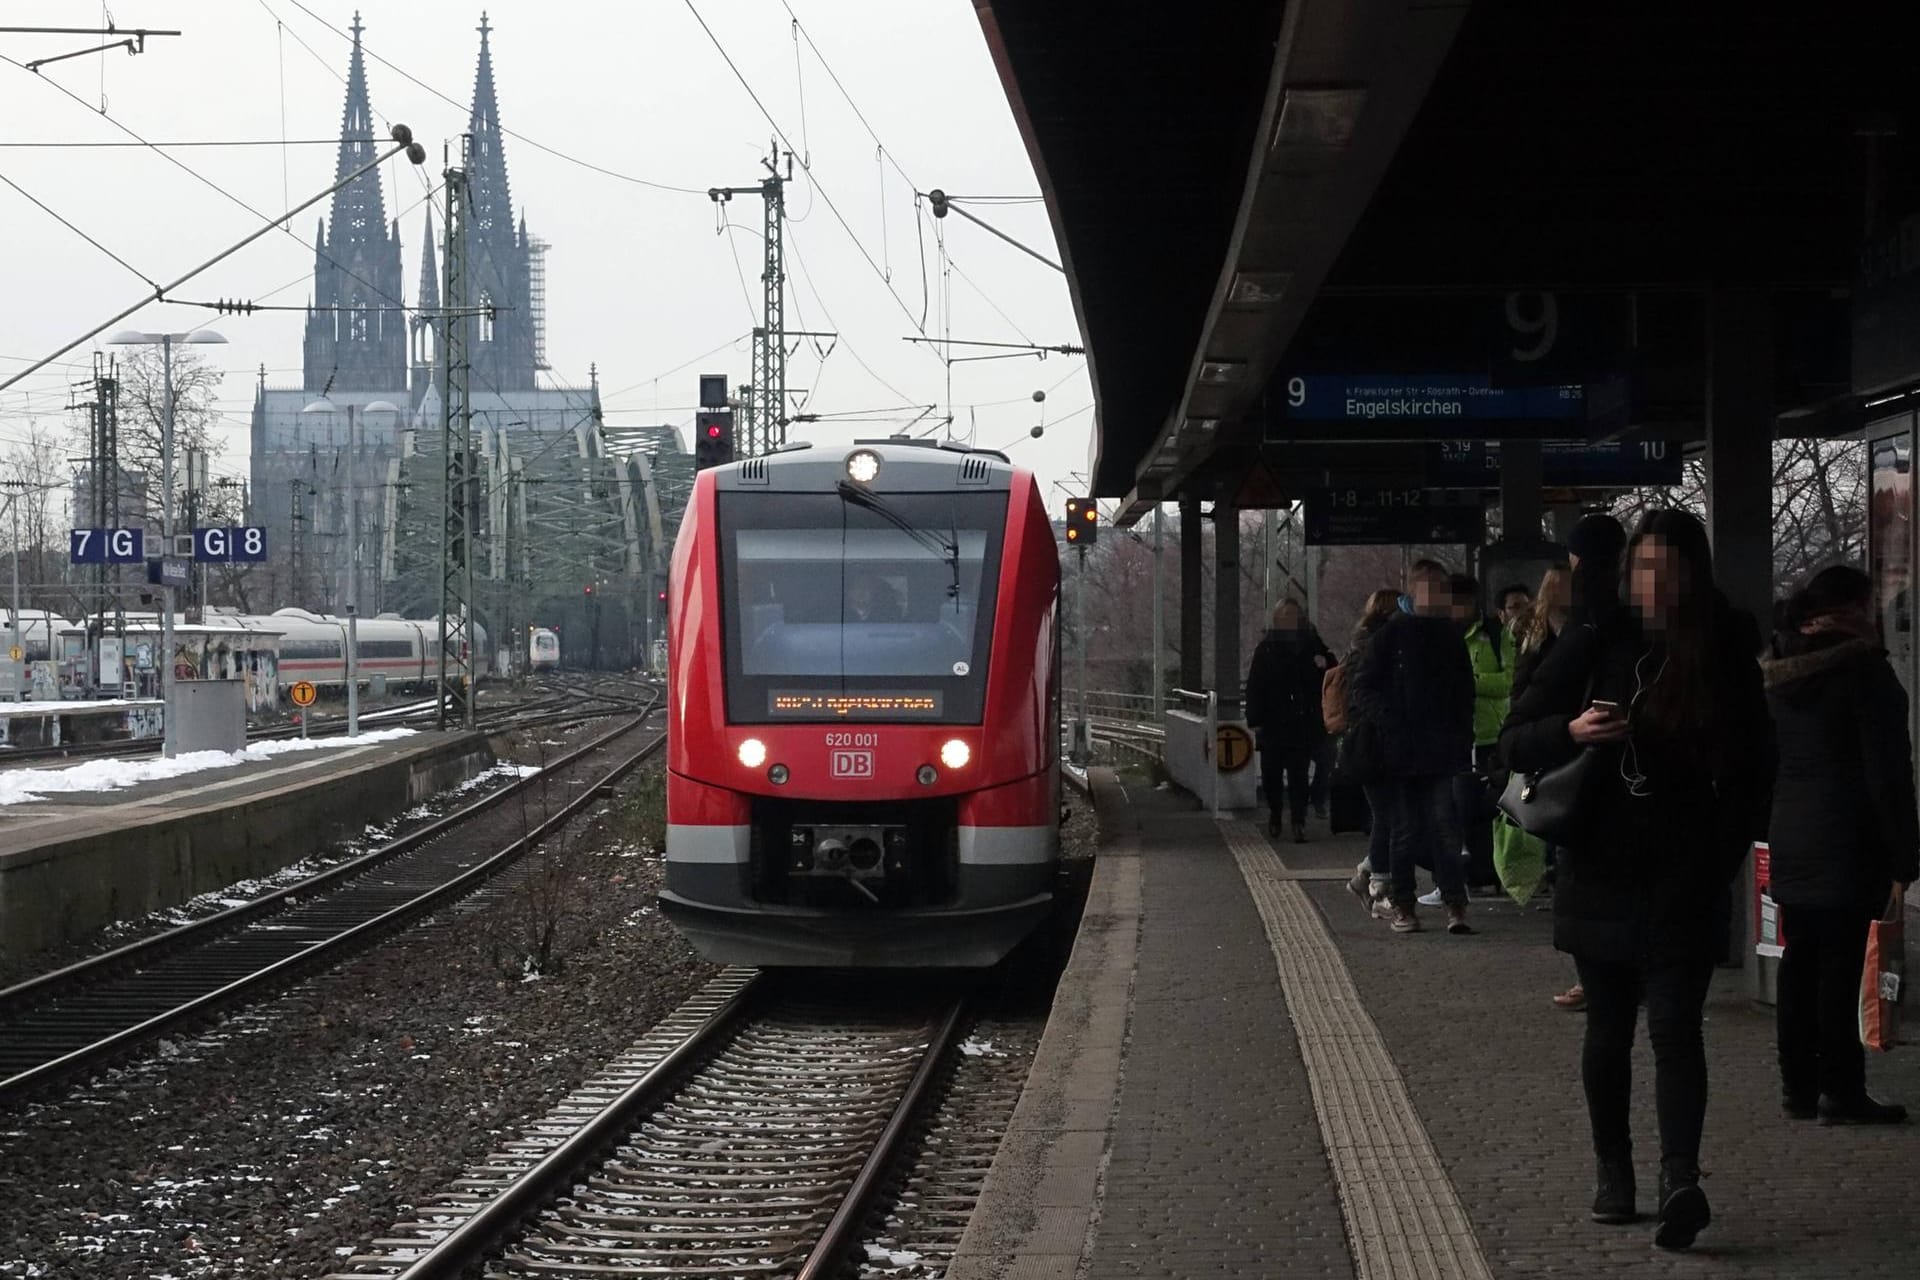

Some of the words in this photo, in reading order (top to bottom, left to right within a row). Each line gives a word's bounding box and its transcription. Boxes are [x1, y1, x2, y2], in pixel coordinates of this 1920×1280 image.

[1505, 290, 1558, 362] 9
[1287, 376, 1306, 407] 9
[1346, 398, 1462, 419] Engelskirchen
[1329, 490, 1357, 507] 1-8
[1378, 489, 1420, 506] 11-12
[74, 530, 92, 556] 7
[112, 529, 133, 556] G
[204, 528, 225, 556] G
[244, 528, 262, 555] 8
[825, 733, 852, 747] 620
[855, 733, 879, 747] 001
[836, 754, 869, 774] DB
